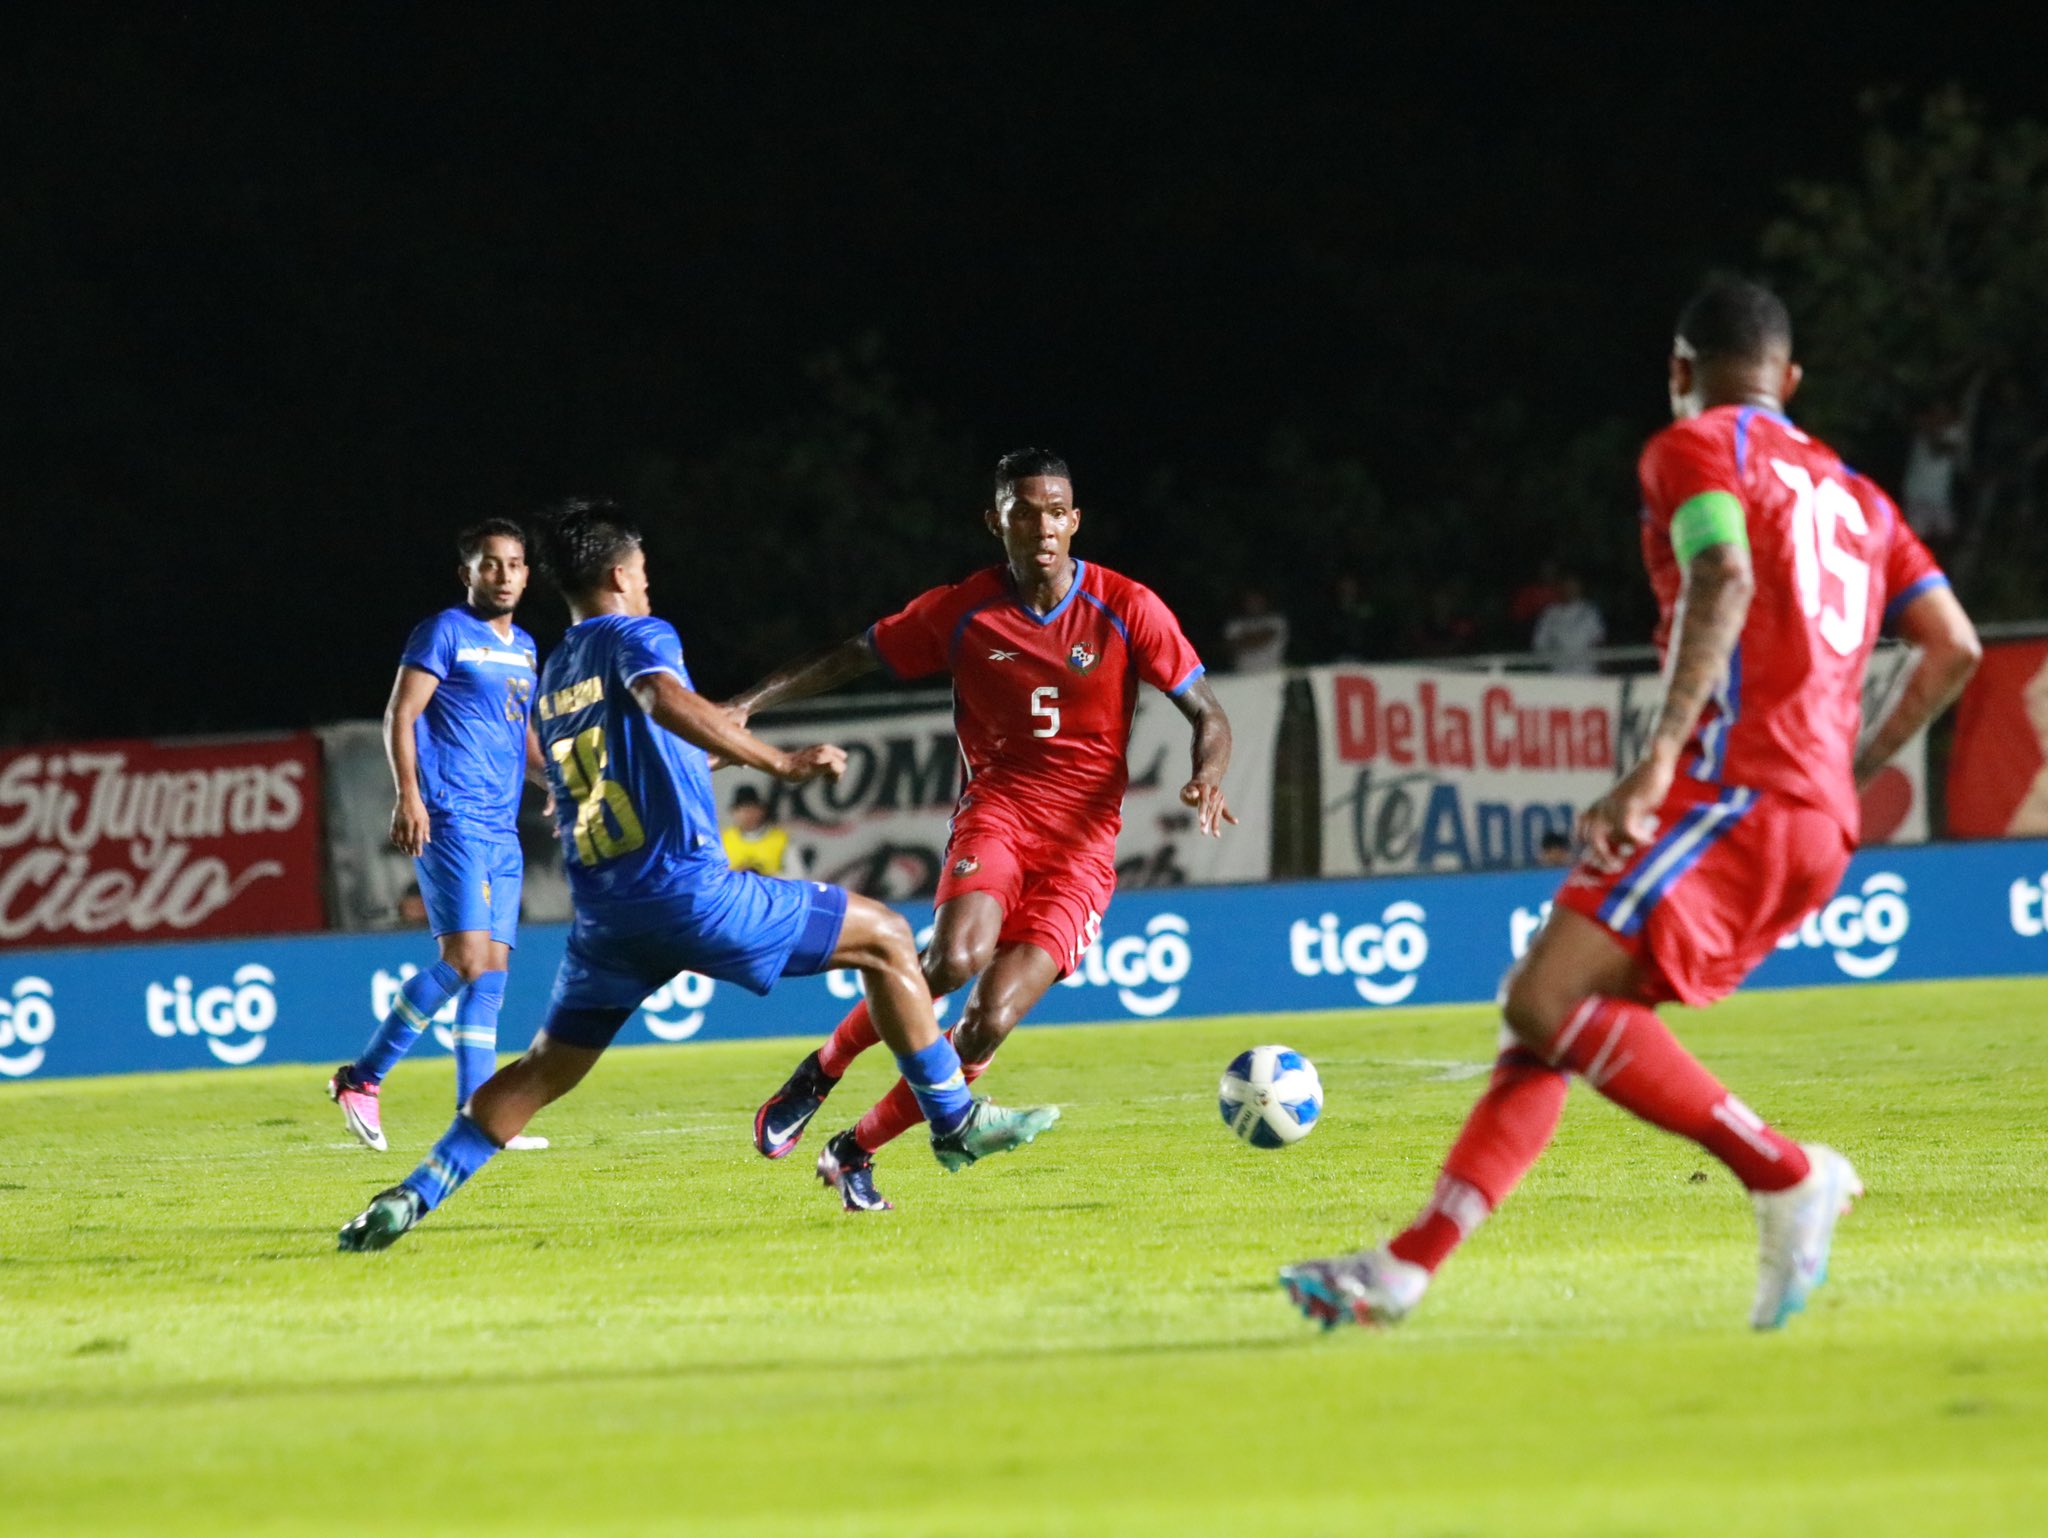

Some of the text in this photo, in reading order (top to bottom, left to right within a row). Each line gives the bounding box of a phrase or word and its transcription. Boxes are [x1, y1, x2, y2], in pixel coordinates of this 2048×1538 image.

[1770, 458, 1870, 656] 15
[1031, 686, 1060, 738] 5
[1481, 683, 1615, 770] Cuna
[0, 843, 283, 939] Cielo
